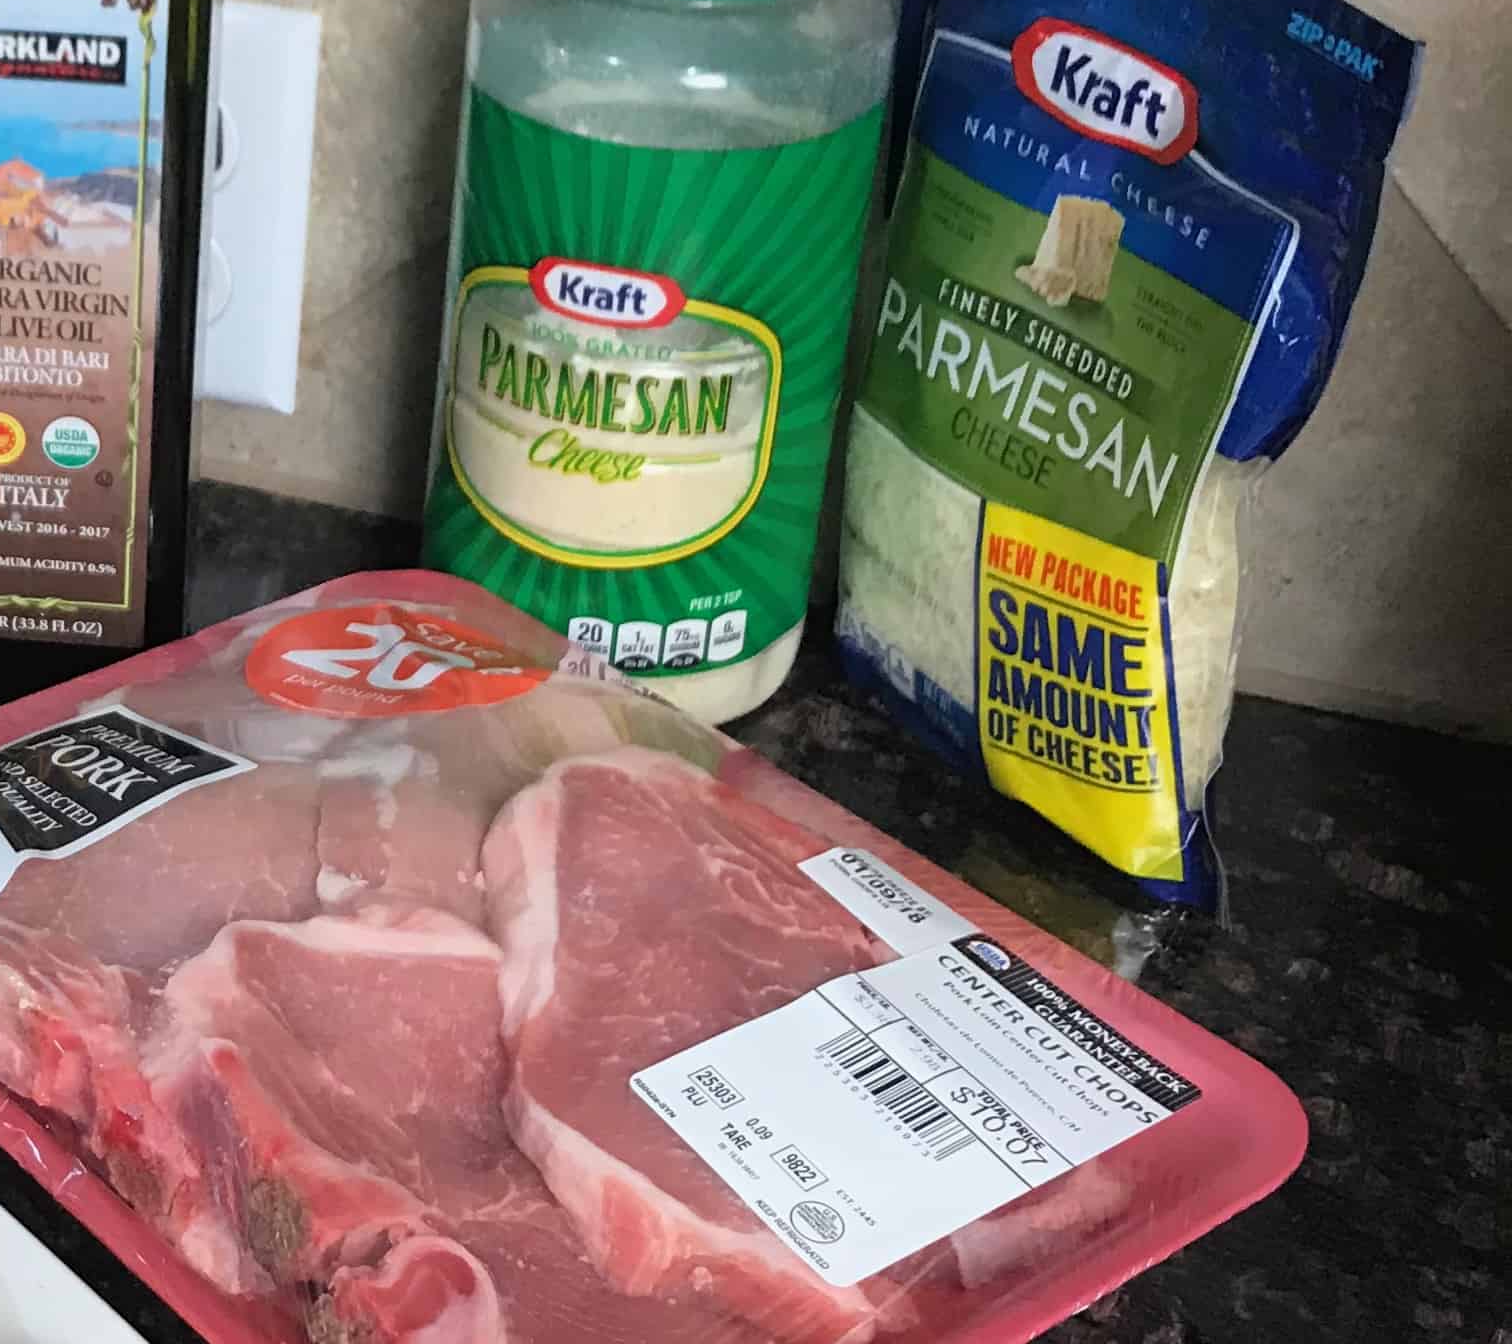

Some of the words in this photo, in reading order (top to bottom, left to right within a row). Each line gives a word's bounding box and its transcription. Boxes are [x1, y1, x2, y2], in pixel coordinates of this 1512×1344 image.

[1286, 11, 1323, 42] ZIP
[1334, 37, 1377, 81] PAK
[1050, 44, 1168, 140] Kraft
[963, 115, 1092, 182] NATURAL
[1111, 172, 1211, 249] CHEESE
[35, 289, 130, 318] VIRGIN
[557, 271, 648, 316] Kraft
[35, 347, 57, 366] DI
[62, 350, 111, 369] BARI
[56, 319, 103, 344] OIL
[938, 278, 1019, 333] FINELY
[1023, 319, 1133, 402] SHREDDED
[478, 322, 733, 435] PARMESAN
[878, 277, 1178, 519] PARMESAN
[54, 428, 88, 442] USDA
[528, 427, 647, 484] Cheese
[951, 406, 1057, 490] CHEESE
[54, 476, 72, 486] OF
[37, 522, 68, 535] 2016
[79, 525, 110, 538] 2017
[33, 558, 87, 573] ACIDITY
[987, 533, 1033, 582] NEW
[1042, 551, 1146, 622] PACKAGE
[12, 616, 49, 632] (33.8
[52, 619, 70, 633] FL.
[72, 620, 103, 637] OZ)
[578, 622, 603, 643] 20
[988, 588, 1153, 698] SAME
[282, 674, 326, 690] per
[328, 683, 404, 705] pound
[988, 659, 1158, 748] AMOUNT
[26, 733, 159, 801] PORK
[80, 724, 197, 776] PREMIUM
[988, 708, 1020, 745] OF
[1027, 723, 1160, 786] CHEESE!
[20, 775, 98, 828] SELECTED
[841, 853, 926, 923] 01/09/18
[938, 954, 1025, 1024] CENTER
[1024, 1024, 1074, 1062] CUT
[1073, 1063, 1160, 1125] CHOPS
[943, 980, 972, 1006] Pork
[973, 1006, 1001, 1031] Loin
[1002, 1029, 1042, 1064] Center
[1044, 1063, 1069, 1086] Cut
[1068, 1082, 1109, 1117] Chops
[1026, 977, 1069, 1011] 100%
[1068, 1009, 1190, 1095] MONEY-BACK
[1034, 1004, 1143, 1085] GUARANTEE
[680, 1085, 709, 1107] PLU
[695, 1069, 737, 1105] 25303
[719, 1122, 753, 1151] TARE
[745, 1117, 774, 1141] 0.09
[950, 1086, 1049, 1166] $10.07
[976, 1089, 1011, 1122] TOTAL
[1009, 1120, 1046, 1151] PRICE
[781, 1152, 817, 1184] 9822
[755, 1199, 778, 1219] KEEP
[774, 1216, 831, 1271] REFRIGERATED
